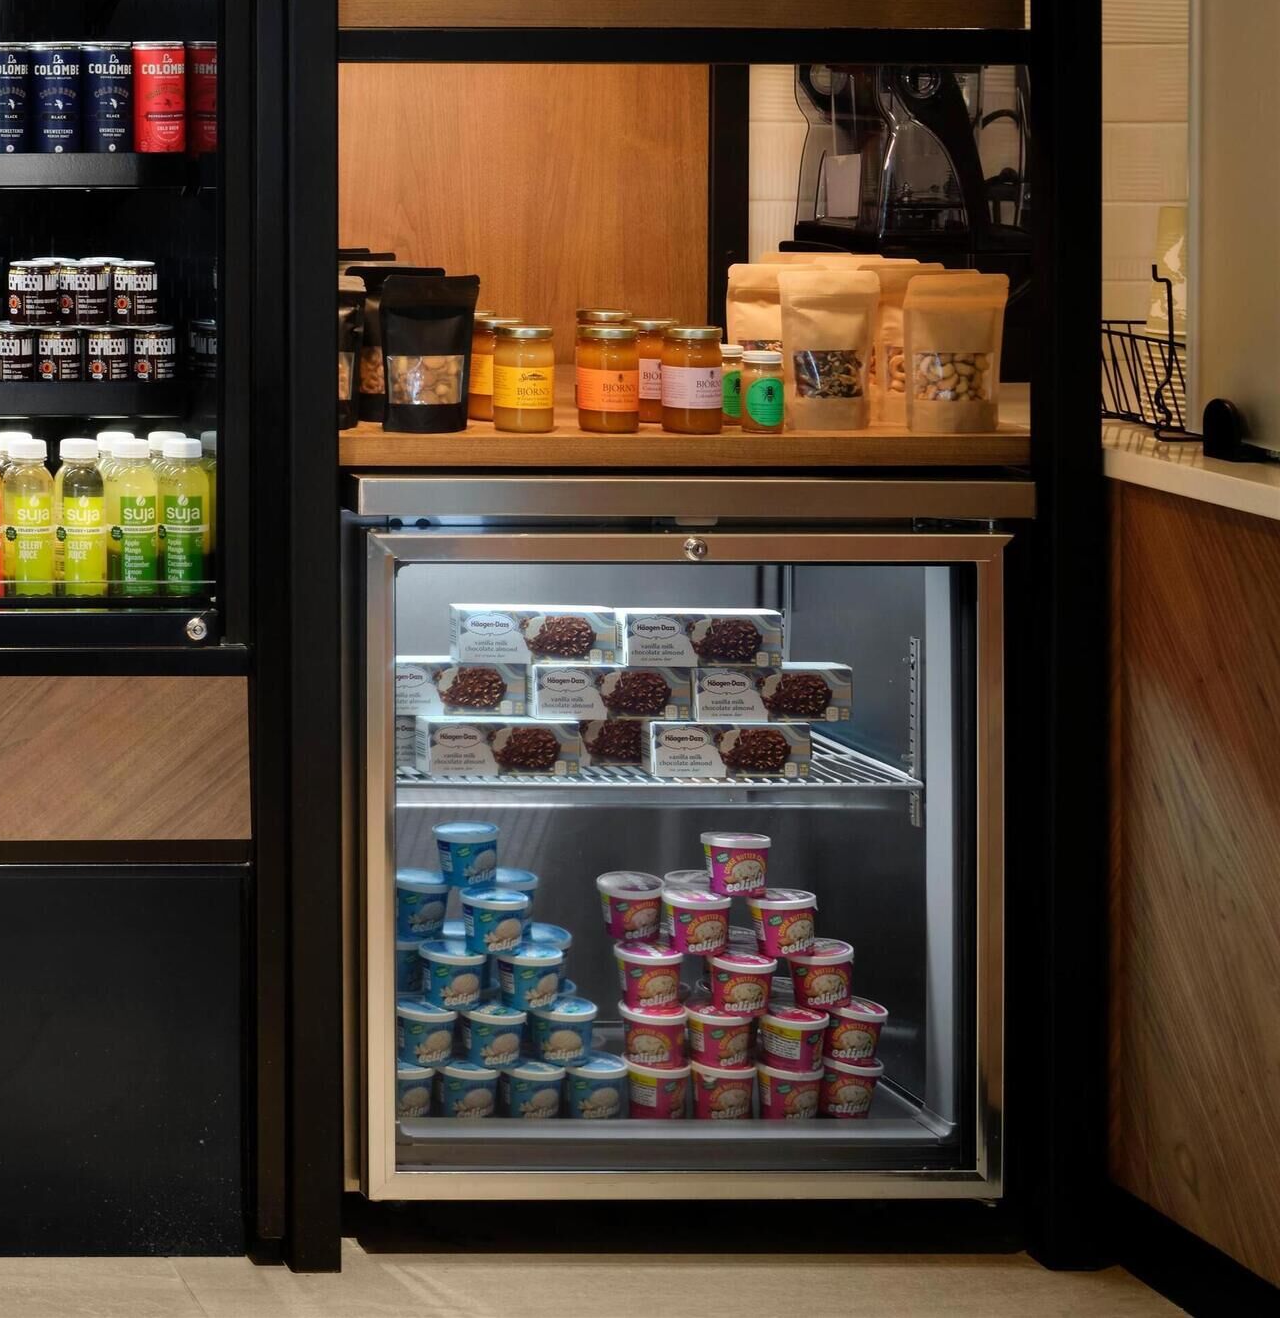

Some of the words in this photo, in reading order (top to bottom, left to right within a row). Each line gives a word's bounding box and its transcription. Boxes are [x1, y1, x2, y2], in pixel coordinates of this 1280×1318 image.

[34, 64, 79, 77] COLOMBE
[67, 507, 100, 524] suja
[124, 505, 155, 523] suja
[18, 541, 43, 550] CELERY
[19, 550, 38, 560] JUICE
[470, 620, 510, 630] Häagen-Dazs
[547, 676, 585, 686] Häagen-Dazs
[665, 734, 703, 744] Häagen-Dazs
